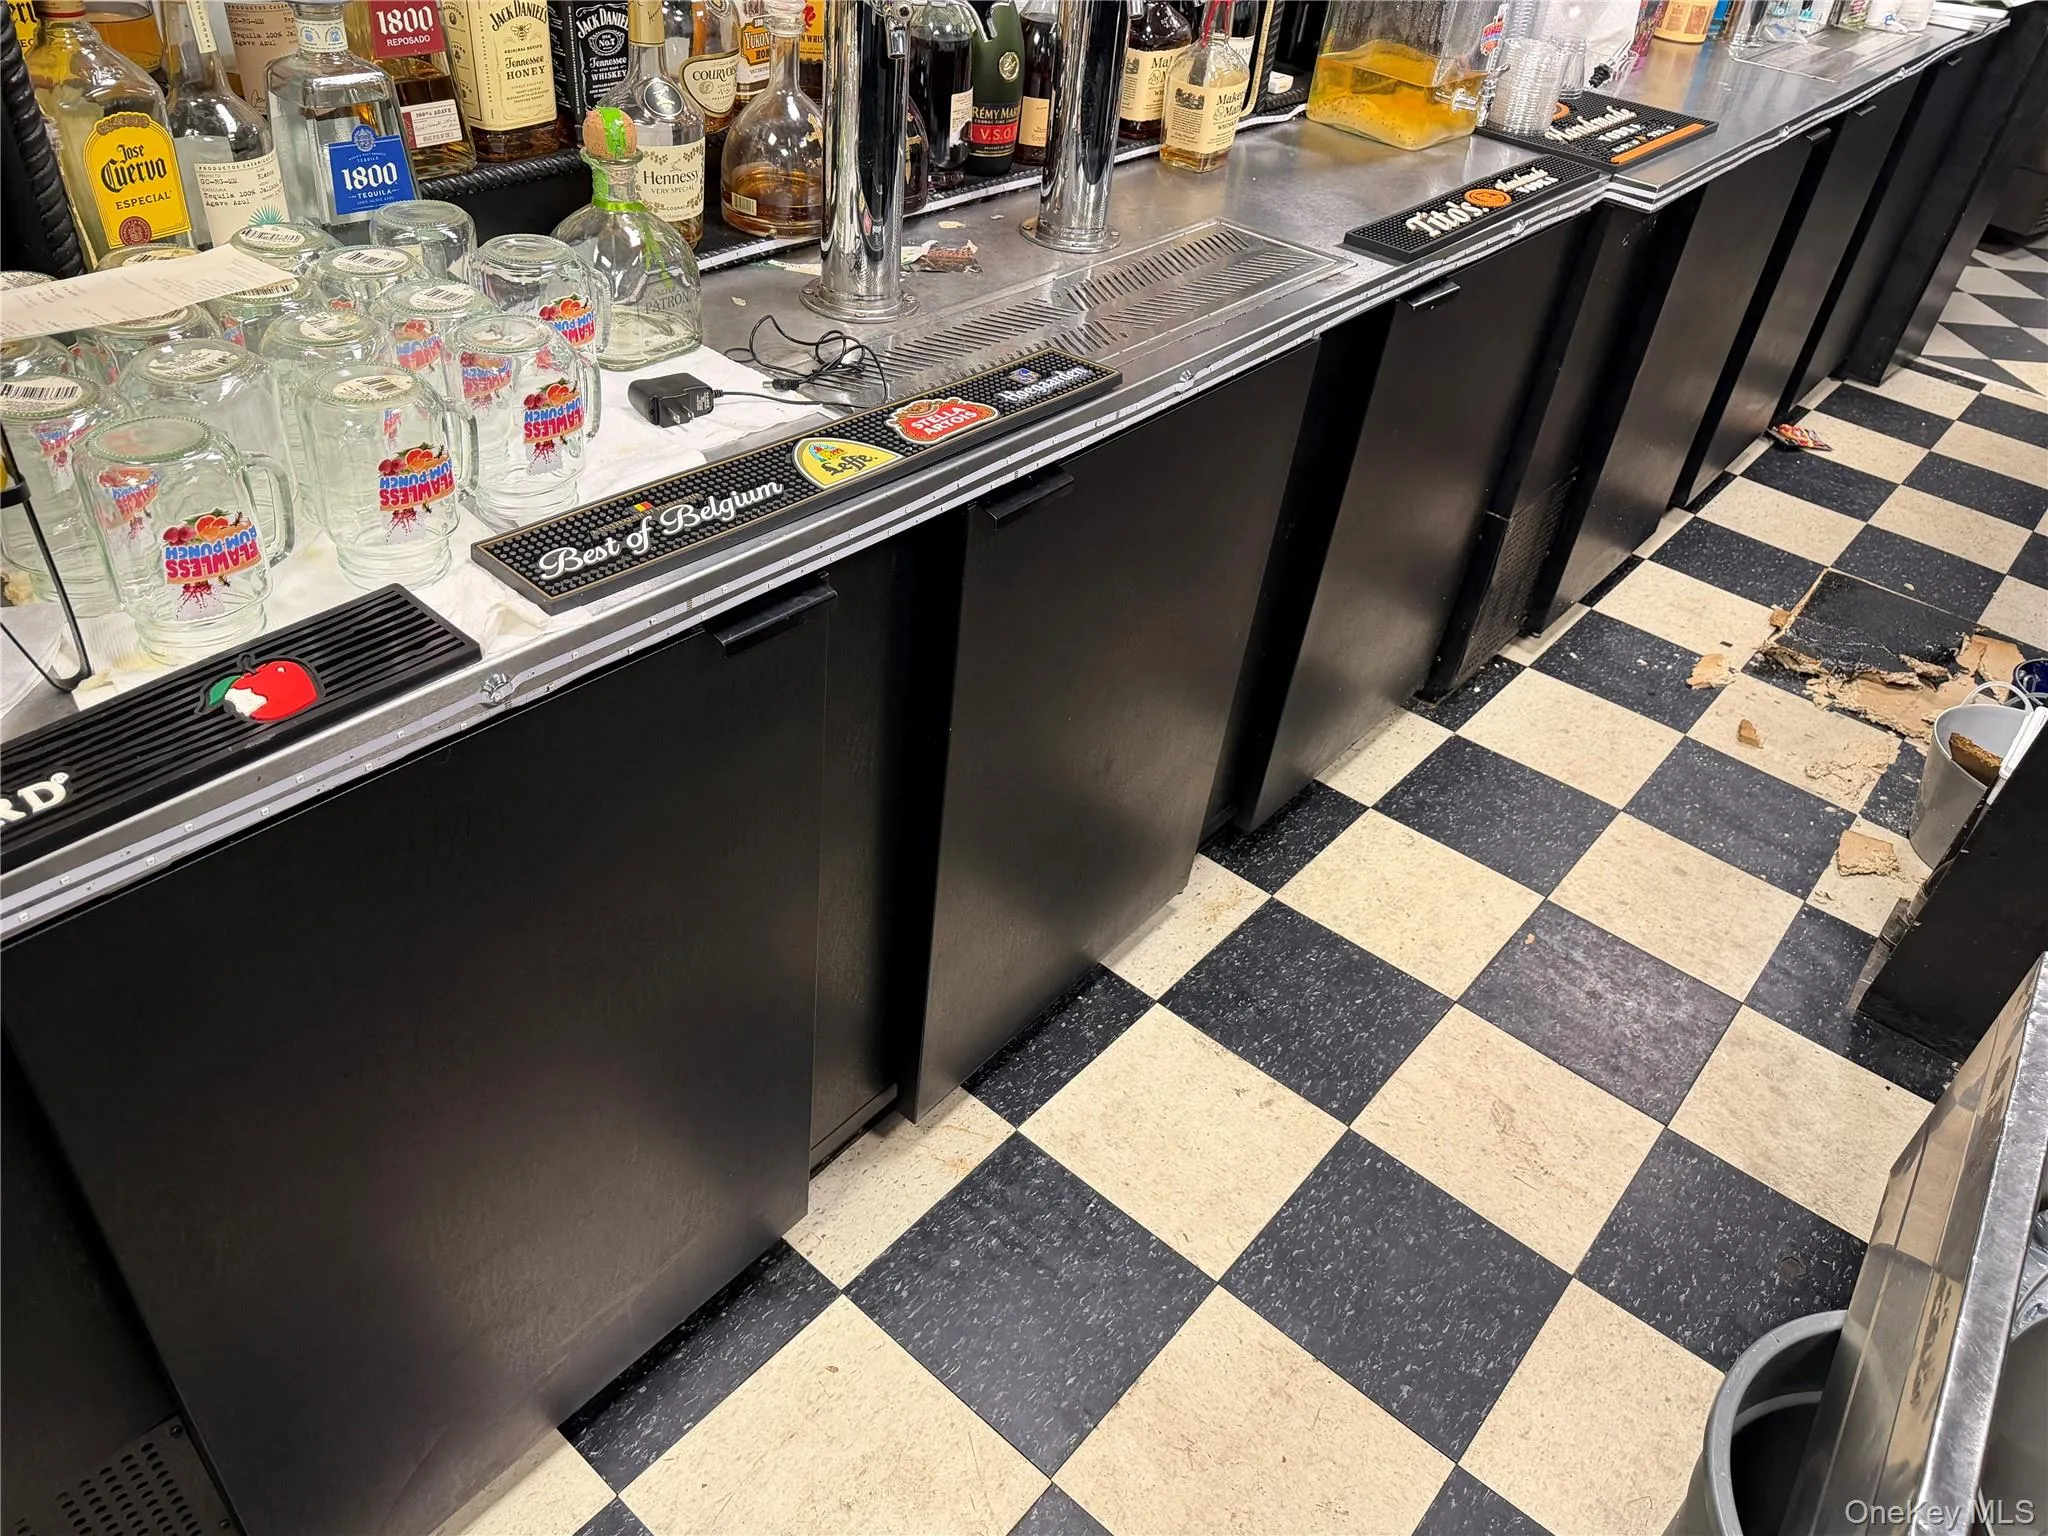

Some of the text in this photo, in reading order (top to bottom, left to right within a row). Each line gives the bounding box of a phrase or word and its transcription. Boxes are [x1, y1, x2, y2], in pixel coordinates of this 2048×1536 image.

[376, 6, 434, 35] 1800
[489, 5, 514, 31] JACK
[575, 8, 628, 39] JACK DANIEL
[387, 34, 430, 47] REPOSADO
[744, 32, 770, 49] YUKON
[505, 55, 544, 69] Tennessee
[506, 65, 545, 80] HONEY
[589, 56, 627, 68] Tennessee
[591, 69, 627, 81] WHISKEY
[973, 105, 1000, 120] RÉMY
[1545, 105, 1638, 143] Handmade
[116, 144, 144, 164] Jose
[100, 157, 167, 193] Cuervo
[341, 162, 398, 191] 1800
[1495, 166, 1549, 192] Handmade
[203, 189, 256, 200] Tequila 100%
[357, 189, 392, 199] TEQUILA
[671, 184, 694, 193] SPECIAL
[115, 191, 171, 210] ESPECIAL
[205, 200, 228, 208] Agave
[645, 289, 689, 314] PATRÓN
[998, 366, 1088, 402] Hoegaarden
[524, 408, 562, 423] PUNCH
[910, 406, 966, 430] STELLA
[923, 409, 978, 435] ARTOIS
[379, 470, 454, 507] FLAWLESS
[380, 471, 427, 489] PUNCH
[538, 480, 783, 580] Best of Belgium
[165, 525, 258, 560] RUM PUNCH
[165, 539, 260, 579] FLAWLESS
